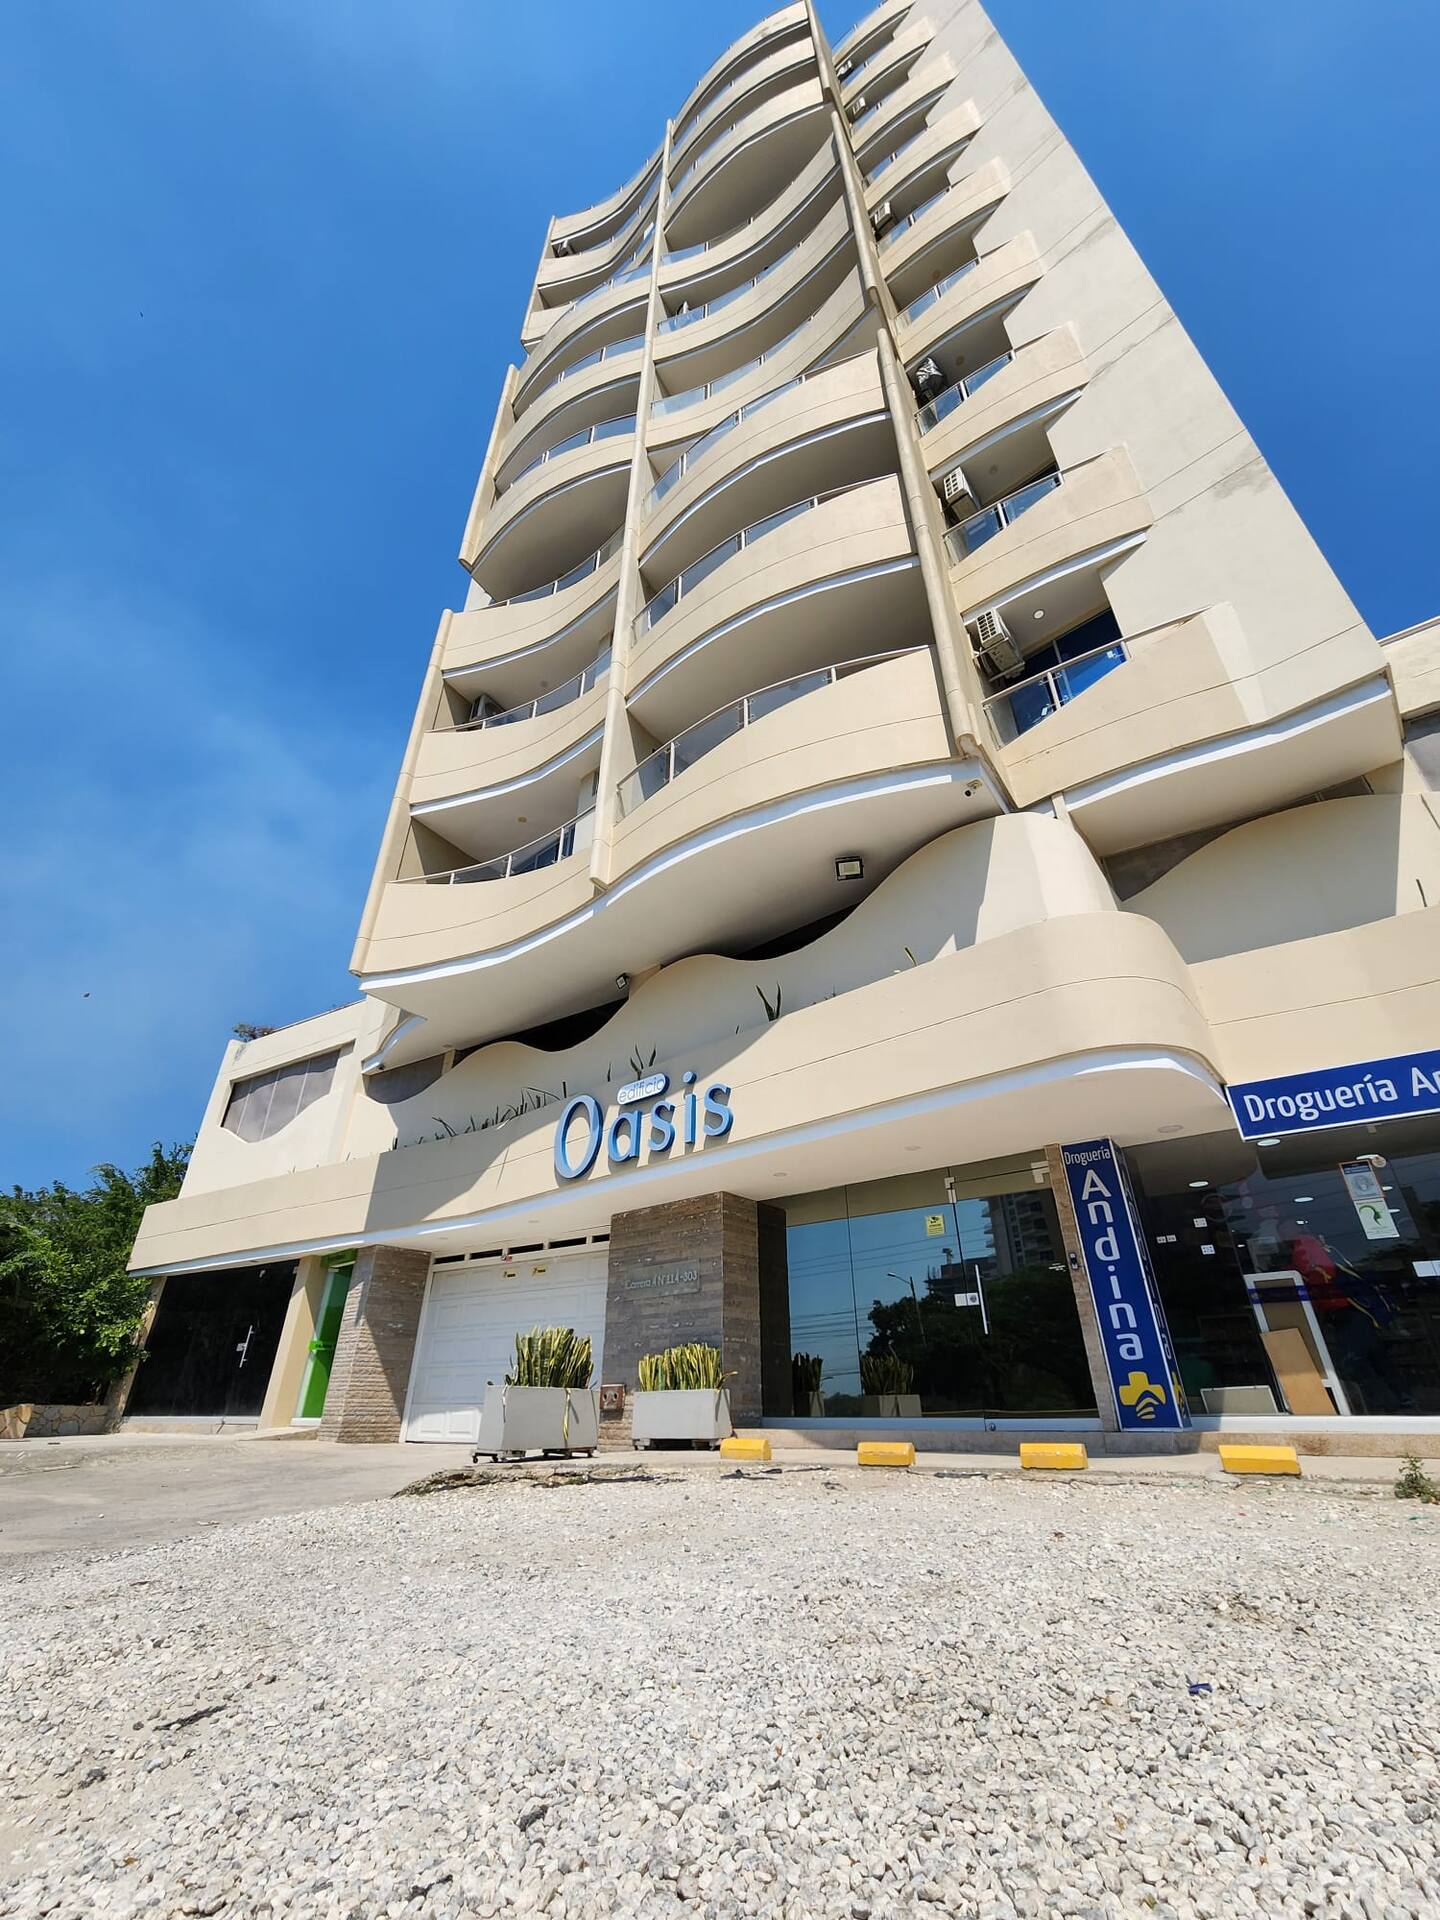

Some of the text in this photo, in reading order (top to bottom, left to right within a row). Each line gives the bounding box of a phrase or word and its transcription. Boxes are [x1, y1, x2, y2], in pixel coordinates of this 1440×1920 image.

[618, 1076, 667, 1103] edificio
[1243, 1073, 1398, 1122] Droguería
[554, 1071, 735, 1179] Oasis
[1063, 1146, 1112, 1167] Droguería
[1081, 1169, 1145, 1361] Andina
